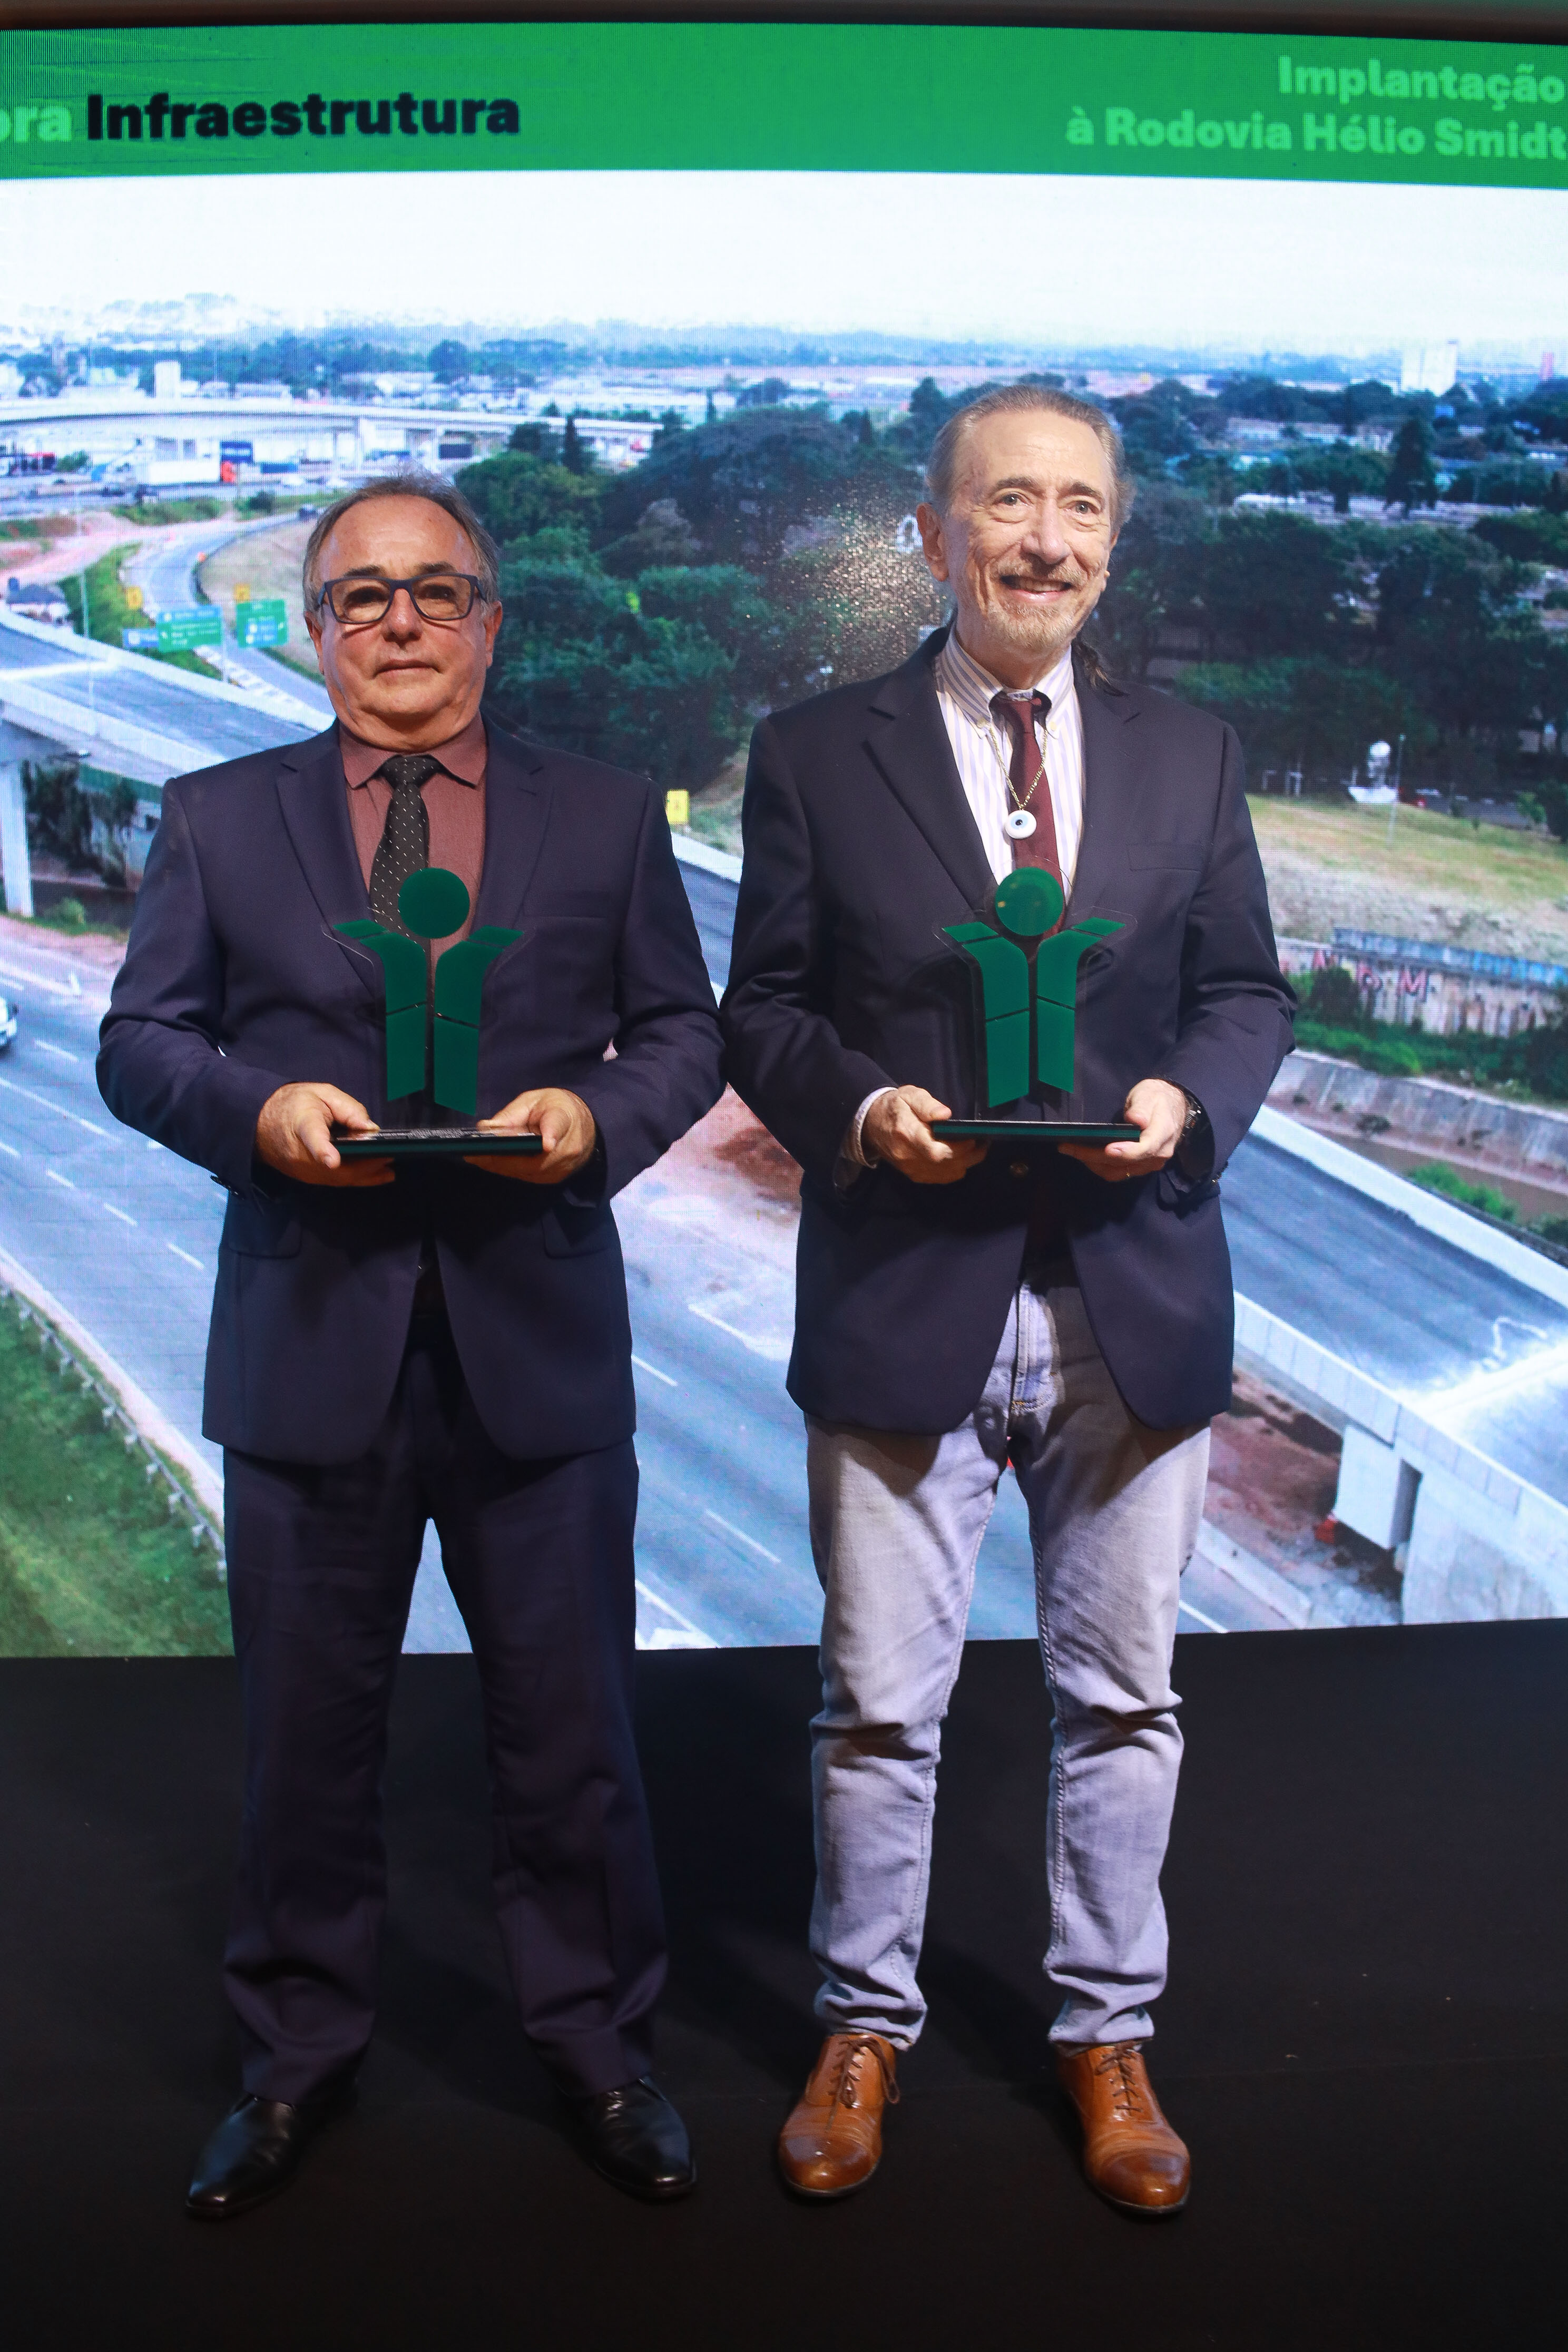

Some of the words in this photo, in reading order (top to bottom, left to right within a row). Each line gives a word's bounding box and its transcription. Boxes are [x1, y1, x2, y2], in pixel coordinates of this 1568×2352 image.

[1278, 55, 1565, 111] Implantação
[87, 92, 520, 140] Infraestrutura
[1065, 106, 1094, 145] à
[1105, 107, 1292, 150] Rodovia
[1302, 112, 1425, 154] Hélio
[1435, 117, 1567, 160] Smidt
